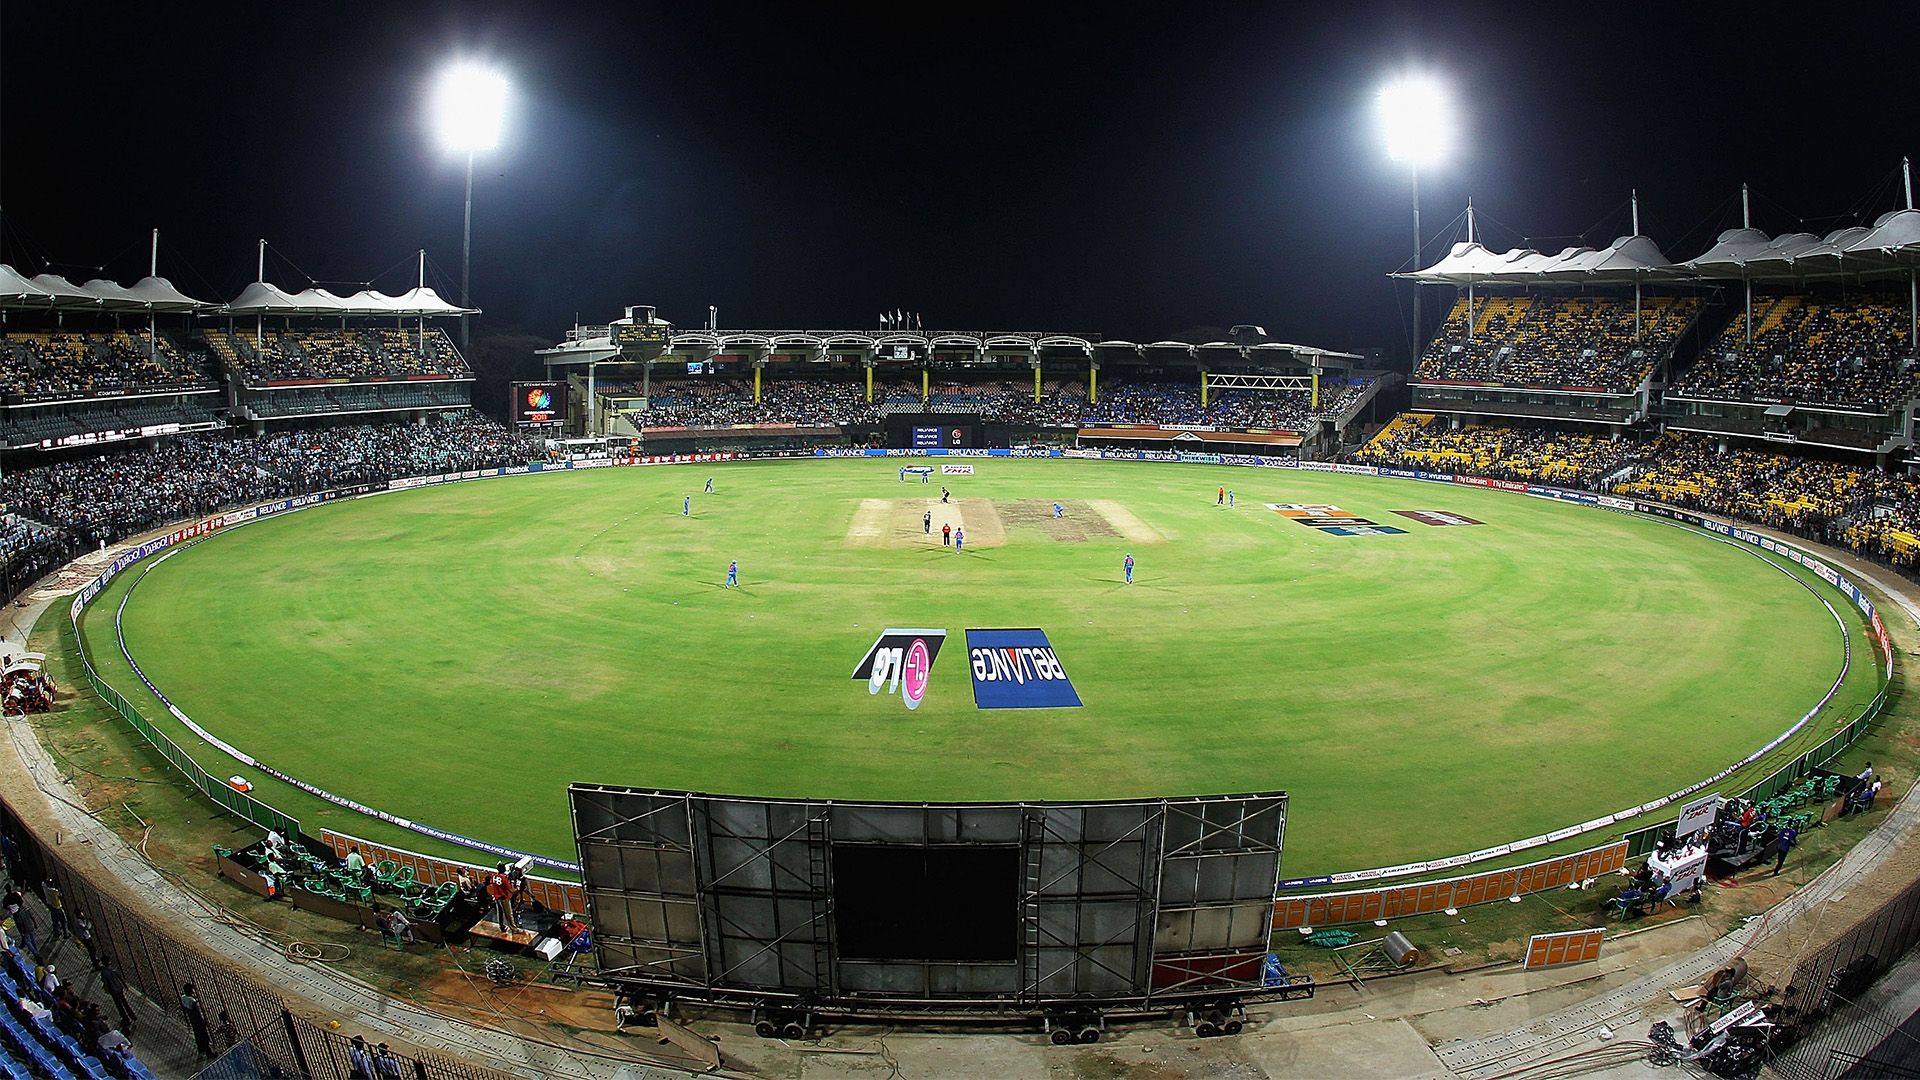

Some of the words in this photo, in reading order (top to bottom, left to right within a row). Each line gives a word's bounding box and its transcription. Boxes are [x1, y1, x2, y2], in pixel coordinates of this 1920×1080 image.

[886, 448, 928, 456] RELIANCE
[948, 448, 989, 456] RELIANCE
[1010, 448, 1051, 456] RELIANCE
[1104, 450, 1138, 459] RELIANCE
[1144, 452, 1178, 461] RELIANCE
[505, 465, 530, 475] Reebok
[542, 460, 567, 470] Reebok
[292, 494, 321, 508] RELIANCE
[259, 502, 287, 516] RELIANCE
[1704, 520, 1730, 535] RELIANCE
[1733, 529, 1759, 545] RELIANCE
[141, 536, 169, 557] YAHOO!
[116, 549, 141, 572] YAHOO!
[870, 646, 903, 692] LG
[971, 646, 1067, 685] RELIANCE
[1680, 798, 1717, 820] KARIZMA
[1670, 859, 1705, 880] KARIZMA
